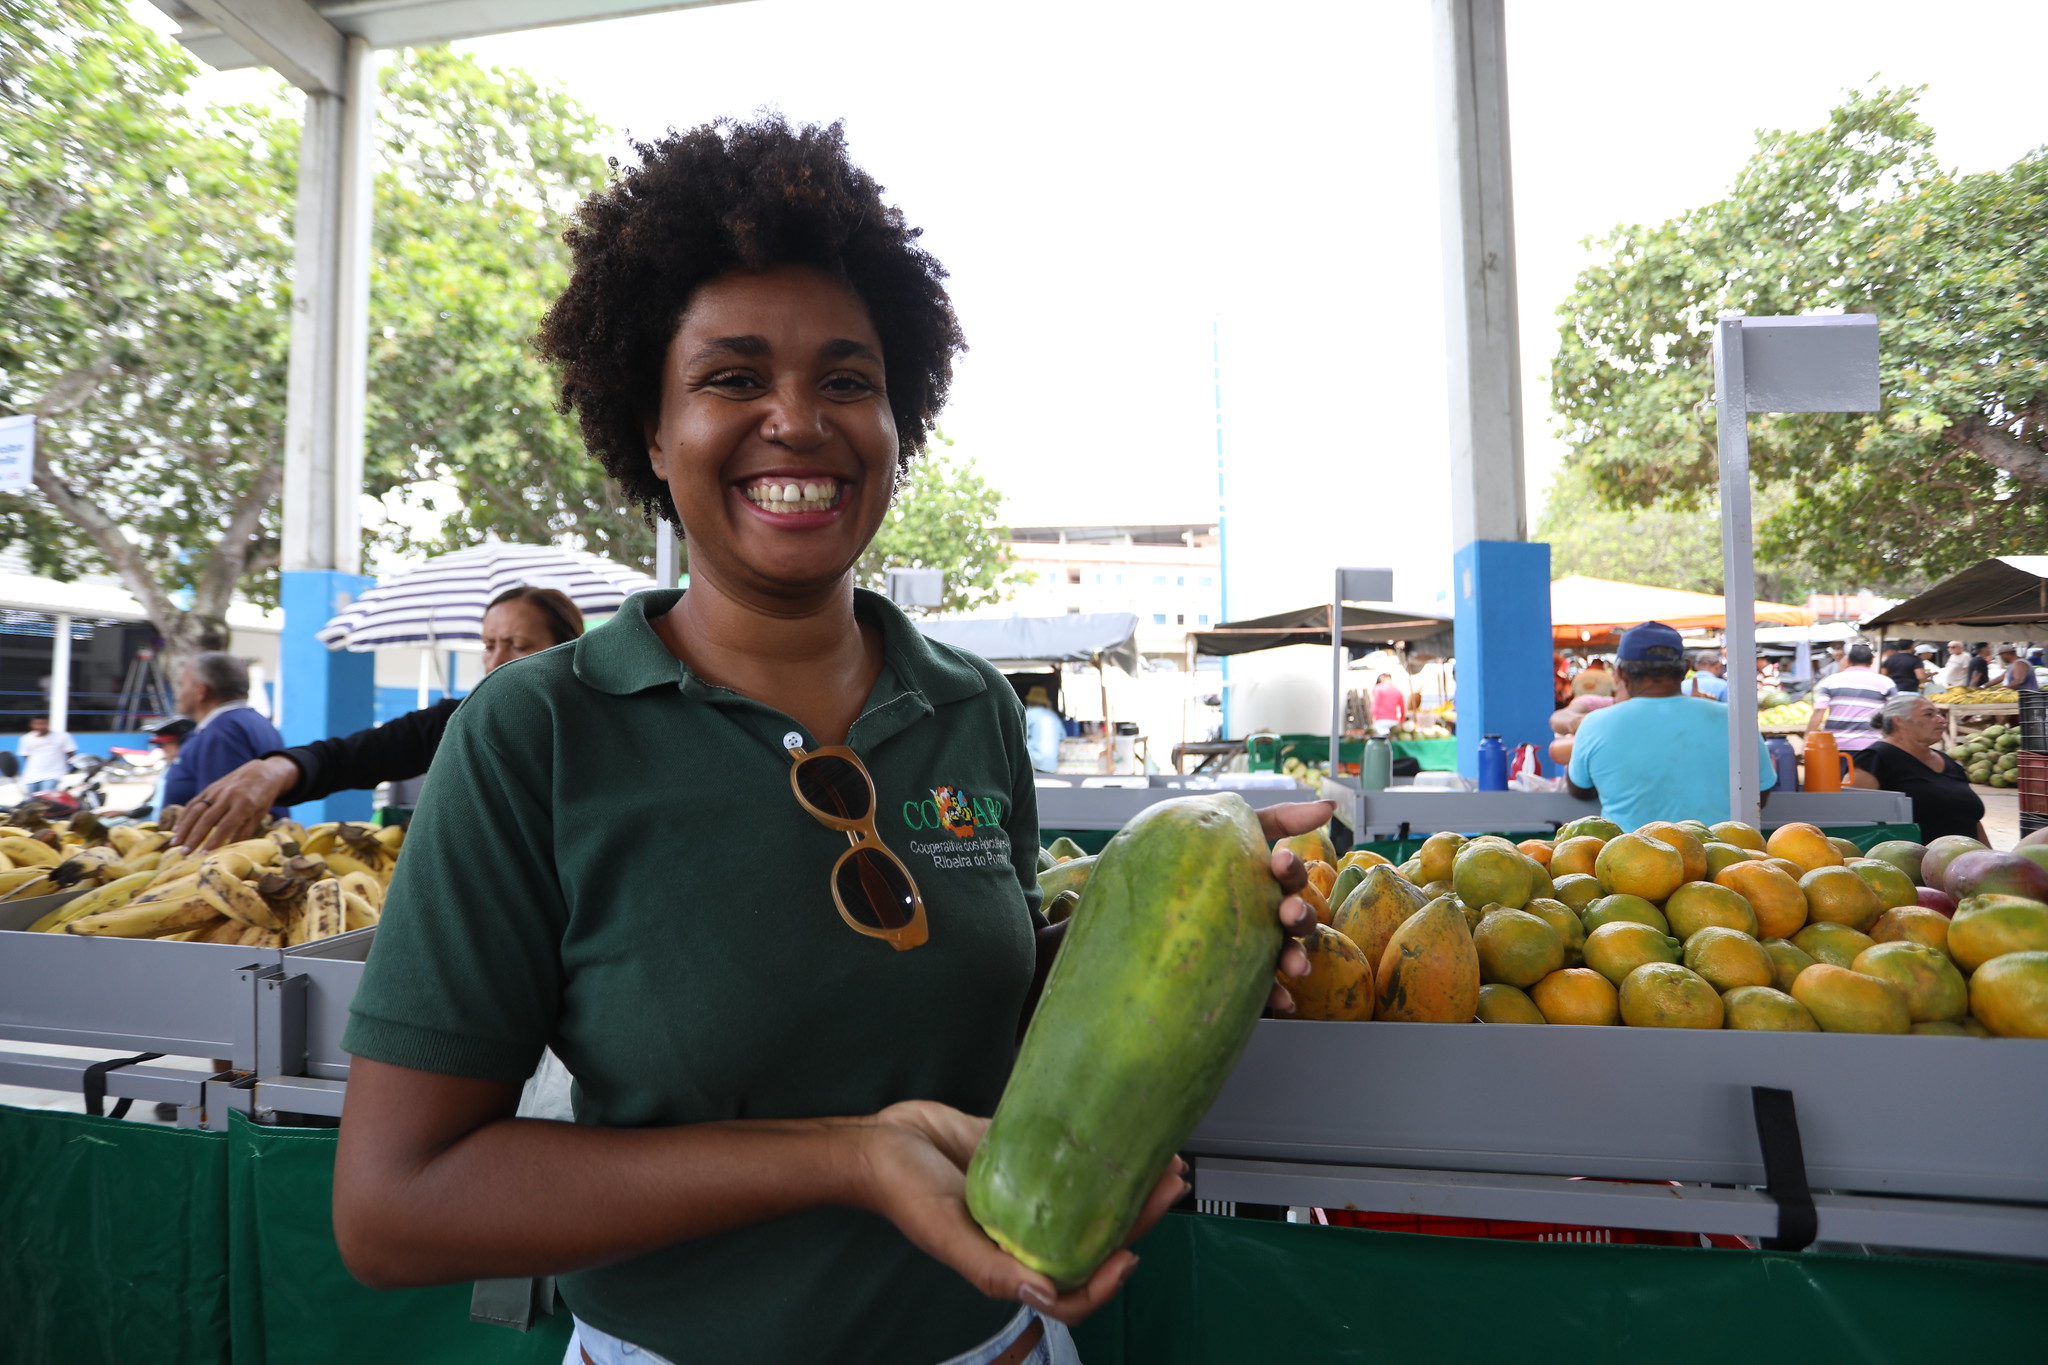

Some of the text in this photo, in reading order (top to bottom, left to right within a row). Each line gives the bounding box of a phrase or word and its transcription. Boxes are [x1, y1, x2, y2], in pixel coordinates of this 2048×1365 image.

[910, 840, 963, 855] Cooperativa
[964, 840, 979, 852] dos
[933, 854, 972, 869] Ribeira
[974, 853, 986, 865] do
